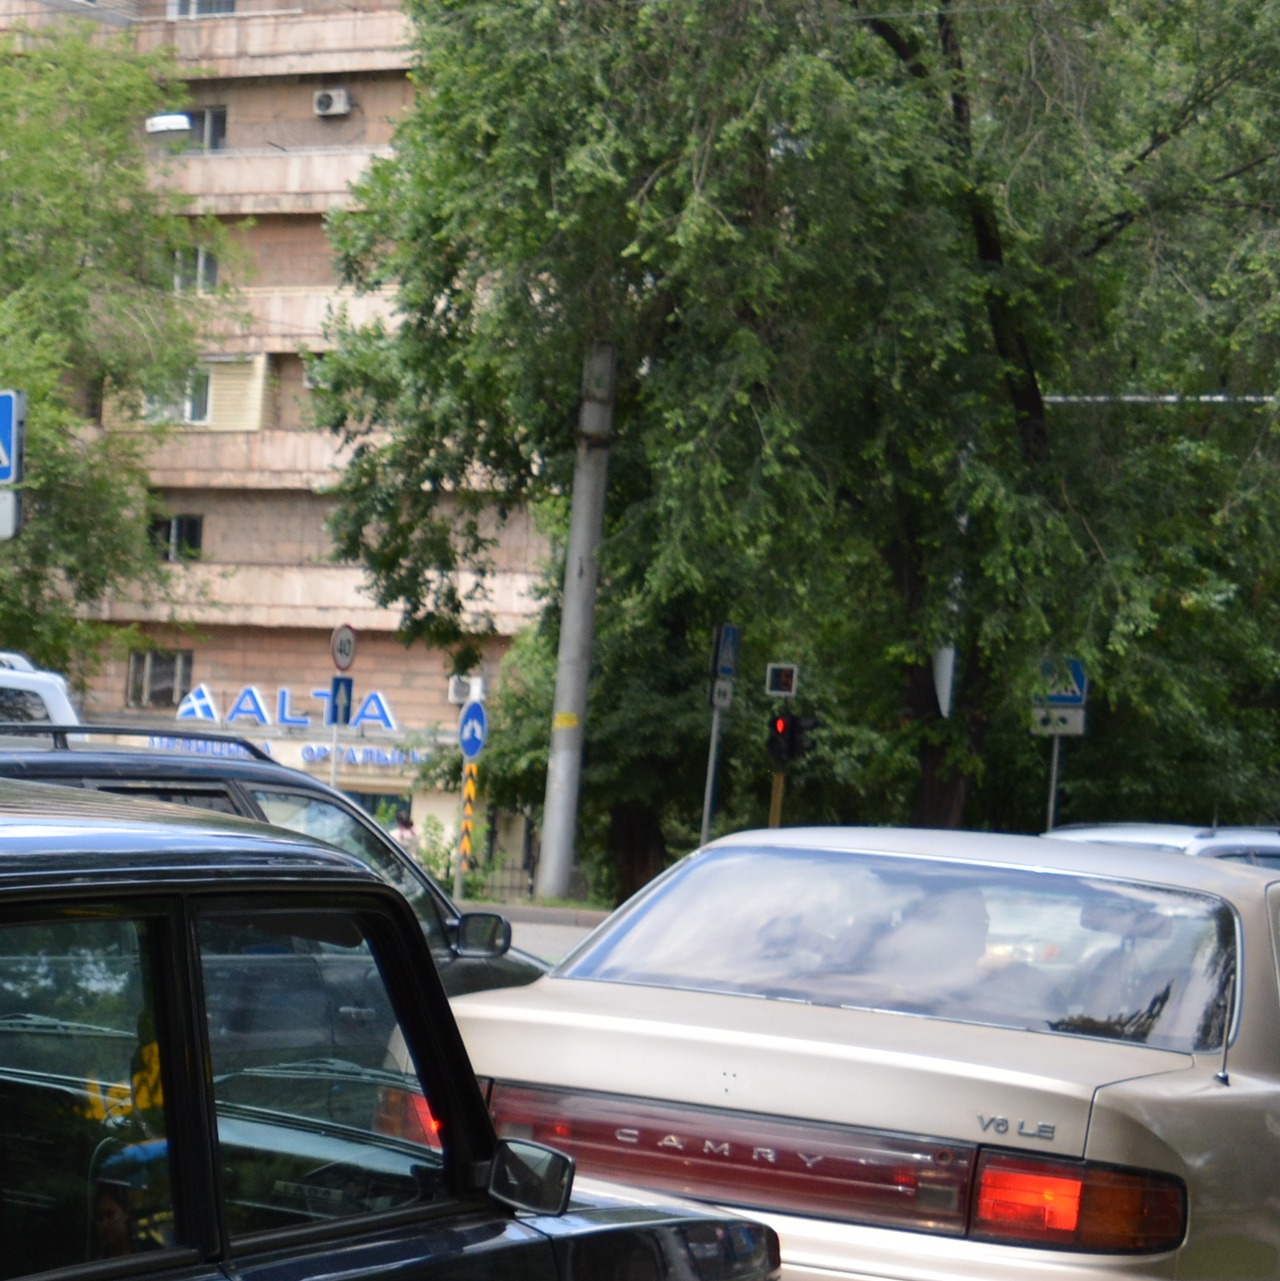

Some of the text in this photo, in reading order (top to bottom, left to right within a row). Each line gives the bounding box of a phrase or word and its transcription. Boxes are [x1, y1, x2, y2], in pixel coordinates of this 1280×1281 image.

[336, 638, 351, 657] 40
[225, 685, 397, 731] ALTA
[977, 1112, 1056, 1141] V6 LE
[614, 1127, 825, 1168] CAMRY
